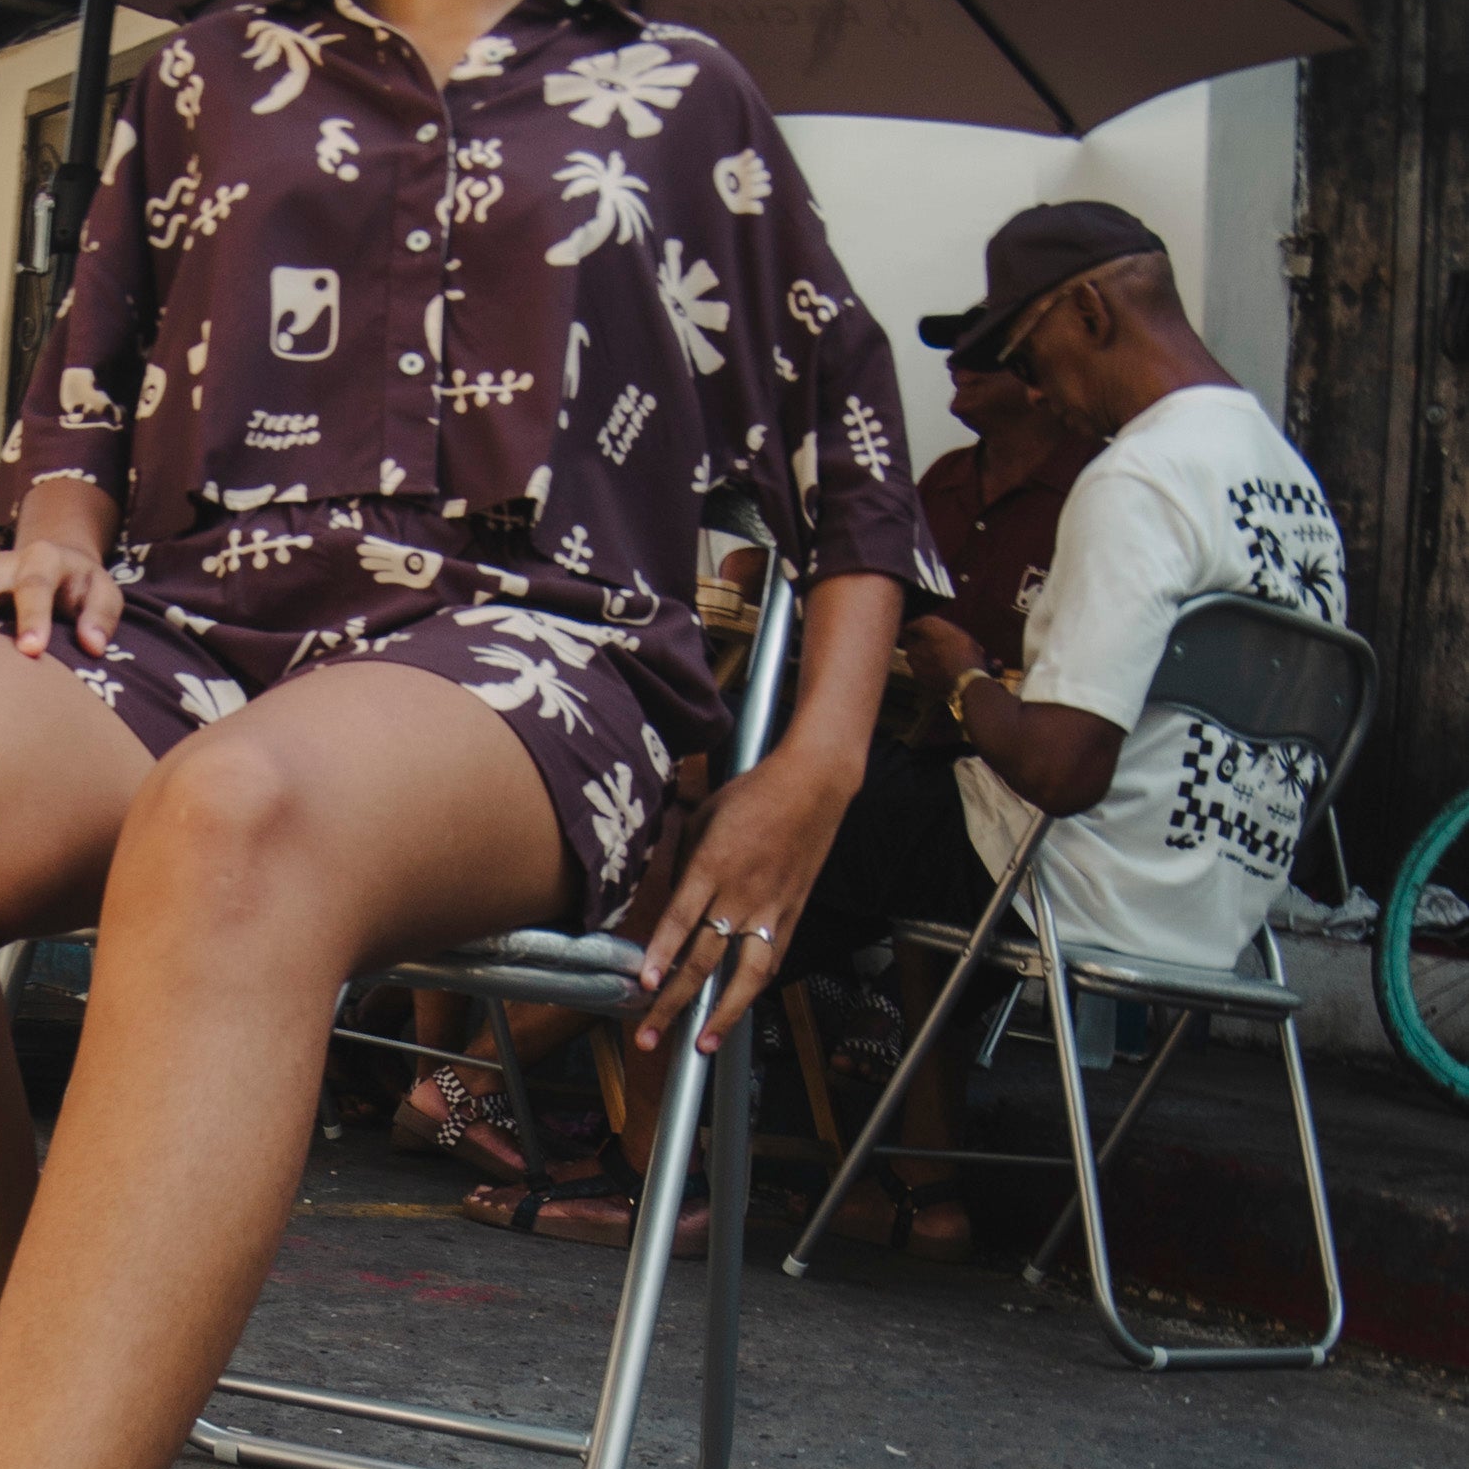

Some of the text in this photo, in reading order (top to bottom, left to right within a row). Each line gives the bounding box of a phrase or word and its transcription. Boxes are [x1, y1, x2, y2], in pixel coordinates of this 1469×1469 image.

[244, 430, 321, 451] LIMPIO
[246, 409, 320, 433] JUEGA
[596, 383, 640, 457] JUEGA
[610, 393, 657, 466] LIMPIO
